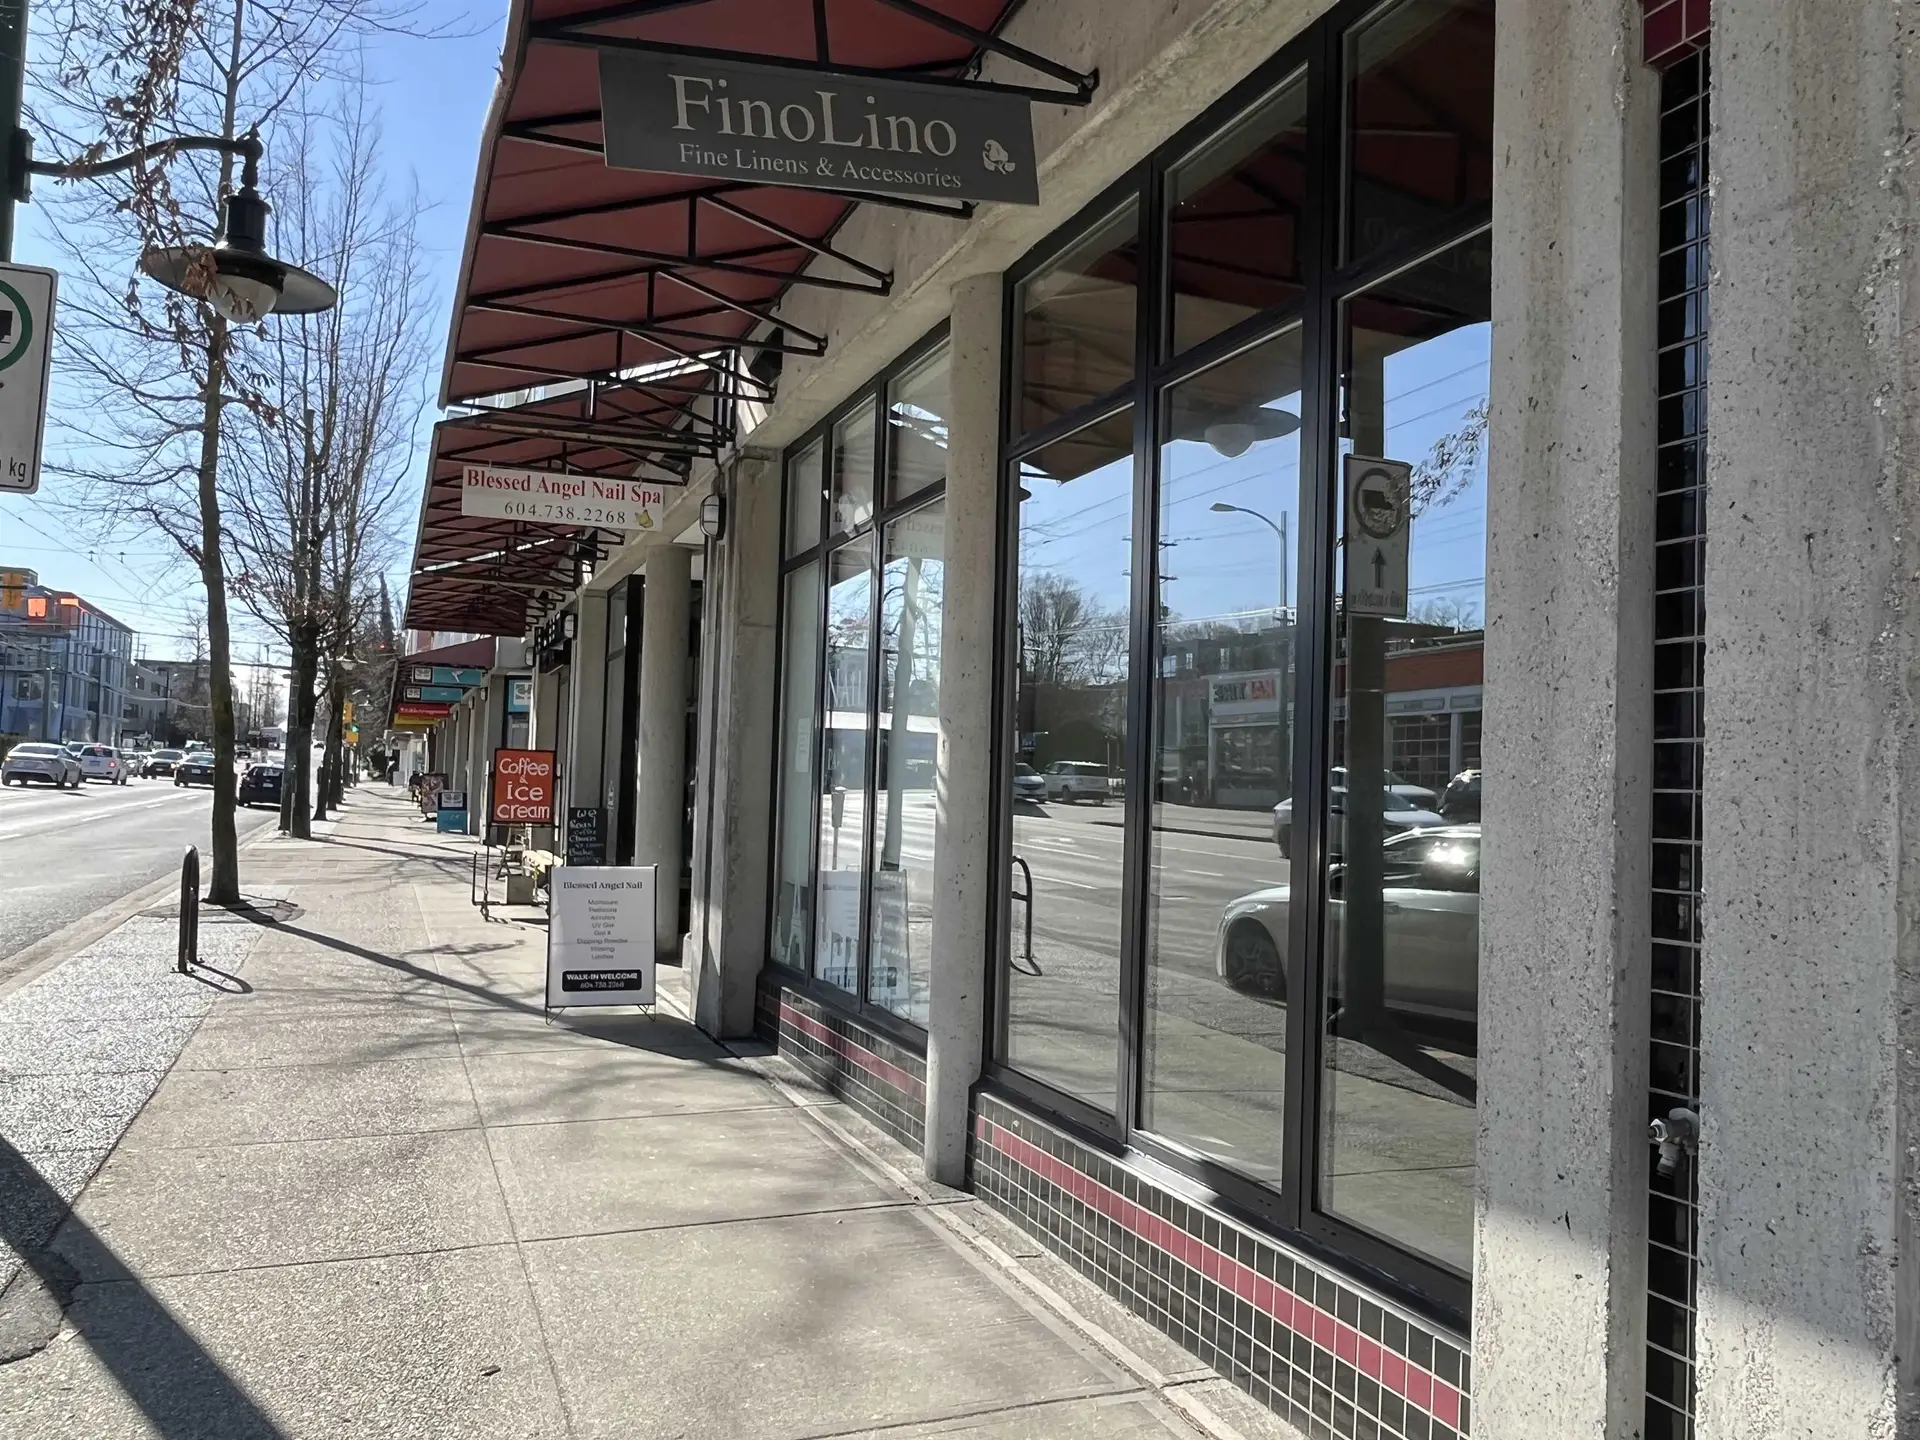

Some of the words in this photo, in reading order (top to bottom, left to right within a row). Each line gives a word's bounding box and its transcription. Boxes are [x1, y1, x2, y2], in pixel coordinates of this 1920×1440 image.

[667, 73, 957, 157] FinoLino
[679, 143, 729, 167] Fine
[735, 149, 808, 176] Linens
[816, 157, 836, 178] &
[842, 164, 962, 189] Accessories
[9, 457, 26, 483] kg
[467, 469, 531, 492] Blessed
[536, 476, 586, 500] Angel
[592, 481, 625, 501] Nail
[631, 485, 661, 507] Spa
[504, 502, 626, 524] 604.738.2268
[499, 757, 550, 777] Coffee
[519, 774, 528, 784] &
[507, 781, 544, 801] ice
[563, 881, 598, 889] Blessed
[599, 881, 624, 891] Angel
[626, 881, 643, 889] Nail
[600, 972, 638, 980] WELCOME
